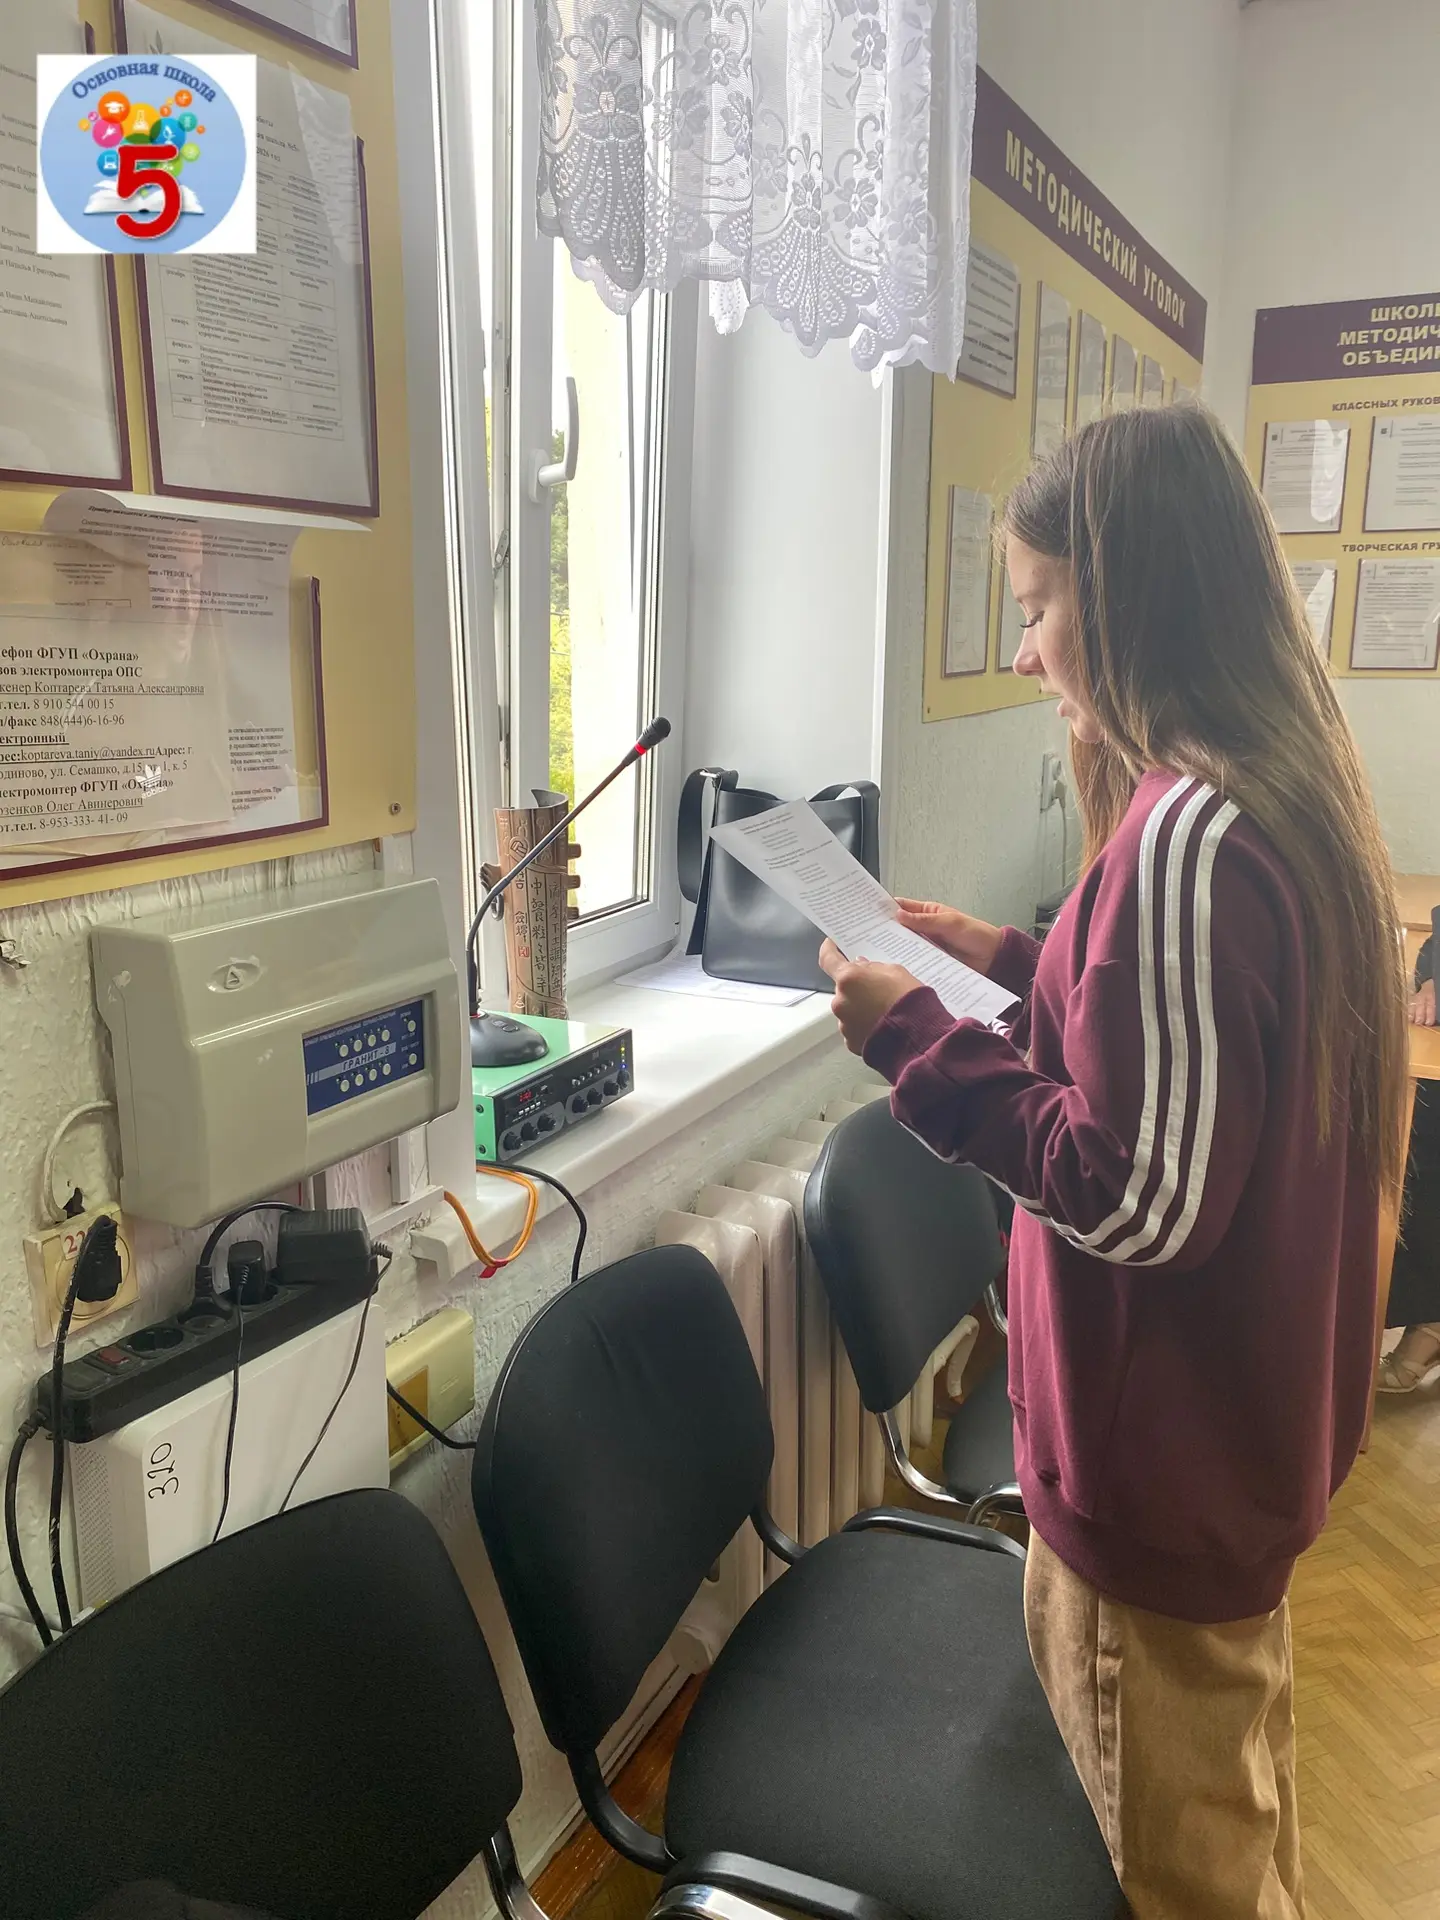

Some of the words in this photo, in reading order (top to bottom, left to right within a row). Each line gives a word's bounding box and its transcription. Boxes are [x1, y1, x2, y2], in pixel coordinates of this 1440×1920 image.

[1005, 129, 1138, 286] МЕТОДИЧЕСКИЙ
[1143, 264, 1187, 328] УГОЛОК
[1339, 324, 1440, 346] МЕТОДИЧ
[1332, 399, 1398, 412] КЛАССНЫХ
[1342, 542, 1418, 552] ТВОРЧЕСКАЯ
[1, 646, 33, 661] ефон
[37, 647, 78, 659] ФГУП
[82, 648, 139, 663] «Охрана»
[20, 667, 113, 679] электромонтера
[116, 666, 143, 677] ОПС
[35, 681, 91, 695] Коптарева
[94, 682, 134, 692] Татьяна
[137, 683, 204, 695] Александровна
[33, 698, 40, 709] 8
[43, 698, 63, 709] 910
[65, 698, 84, 710] 544
[87, 698, 100, 709] 00
[104, 698, 115, 709] 15
[40, 714, 125, 728] 848(444)6-16-96
[50, 768, 66, 779] ул.
[69, 764, 120, 776] Семашко,
[182, 760, 188, 769] 5
[0, 785, 77, 799] ектромонтер
[80, 779, 118, 792] ФГУП
[46, 800, 75, 812] Олег
[116, 811, 128, 822] 09
